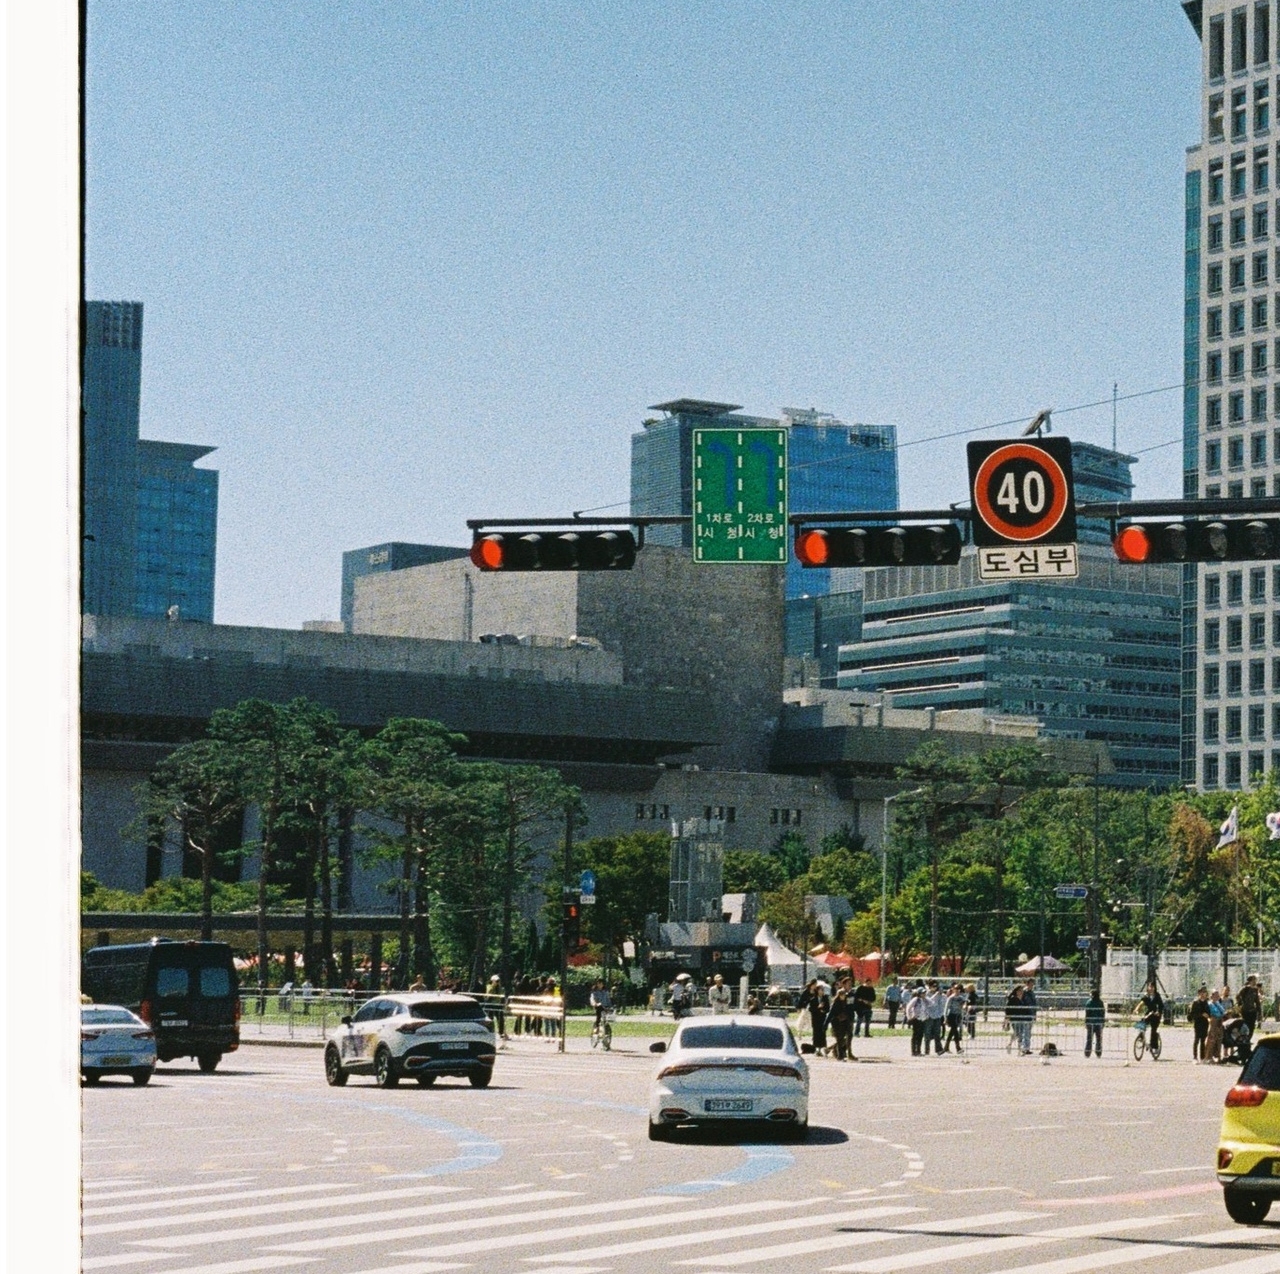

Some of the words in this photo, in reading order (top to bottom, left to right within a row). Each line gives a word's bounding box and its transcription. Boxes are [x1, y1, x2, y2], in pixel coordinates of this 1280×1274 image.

[997, 470, 1046, 514] 40
[706, 513, 733, 524] 1차로
[747, 513, 774, 524] 2차로
[984, 548, 1072, 574] 도심부
